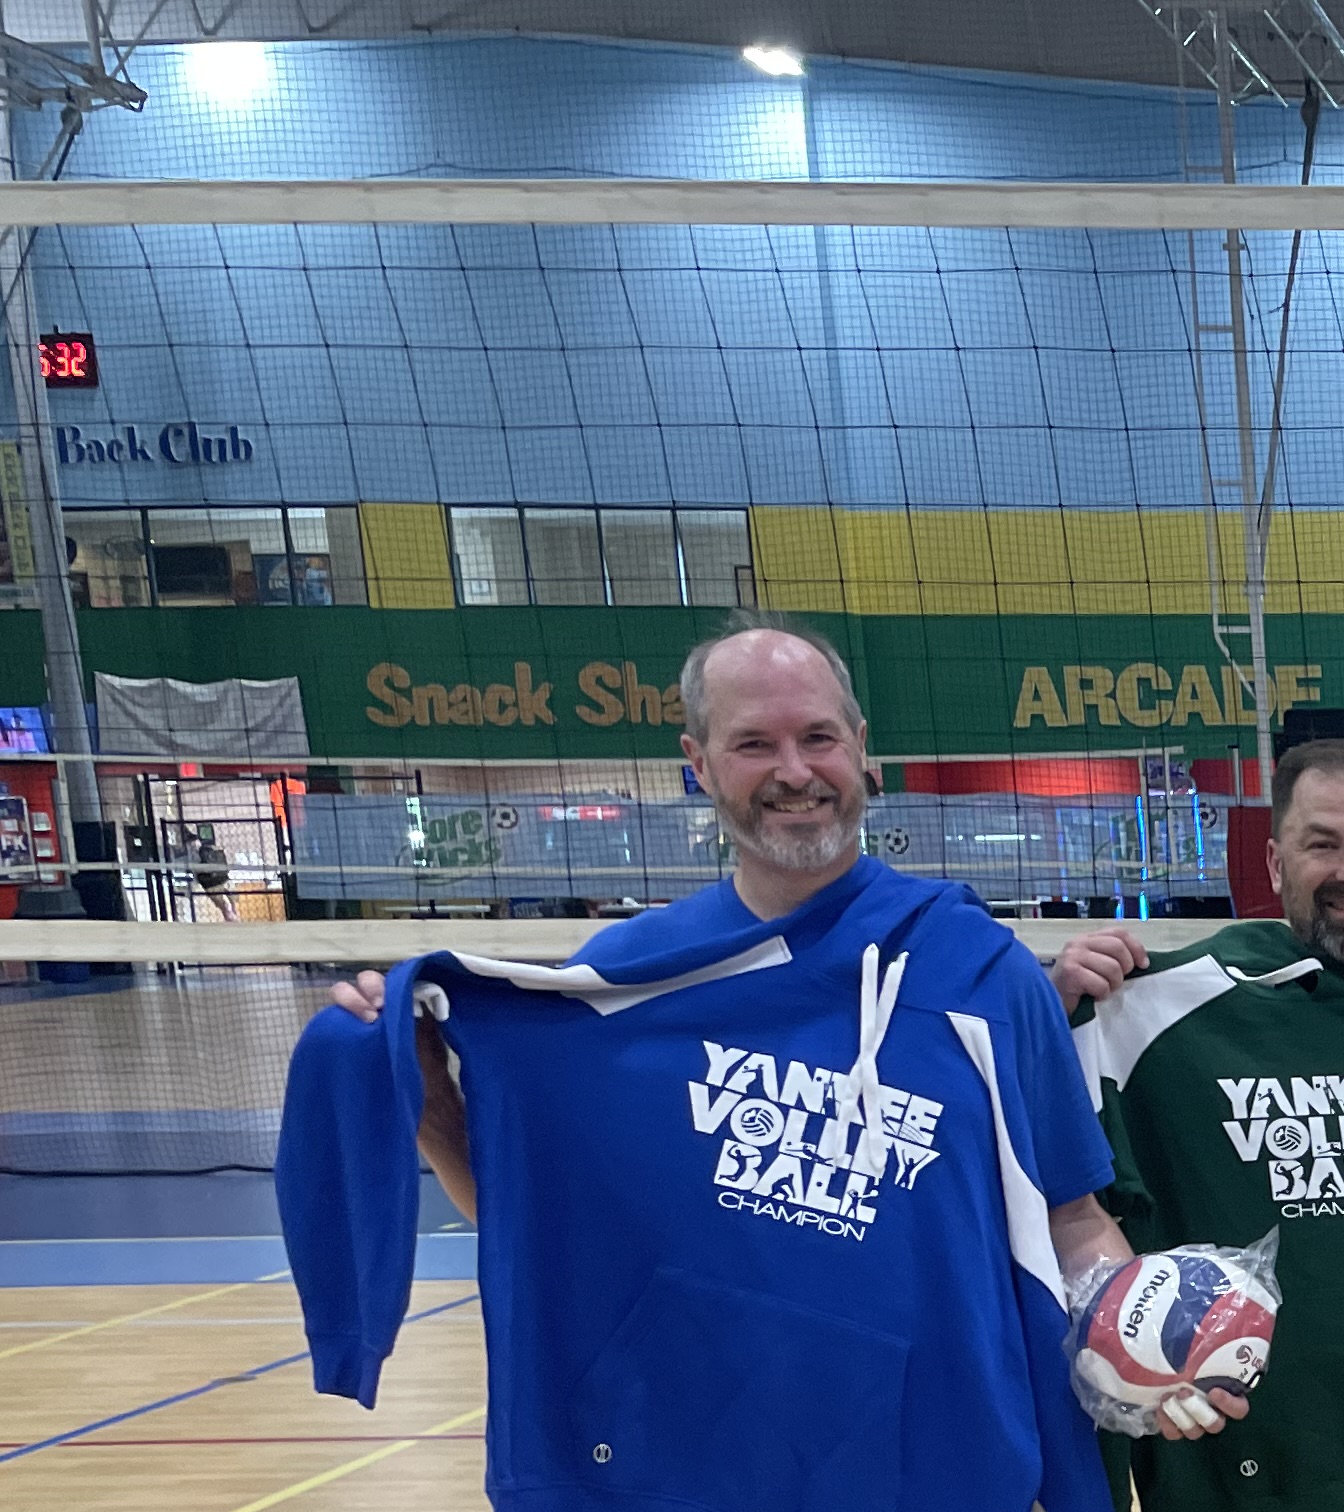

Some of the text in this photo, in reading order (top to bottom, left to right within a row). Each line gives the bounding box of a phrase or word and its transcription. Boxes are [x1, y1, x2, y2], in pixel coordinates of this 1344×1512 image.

[56, 421, 254, 465] Back Club
[365, 660, 558, 728] Snack
[713, 1138, 880, 1224] BALL
[717, 1191, 866, 1242] CHAMPION
